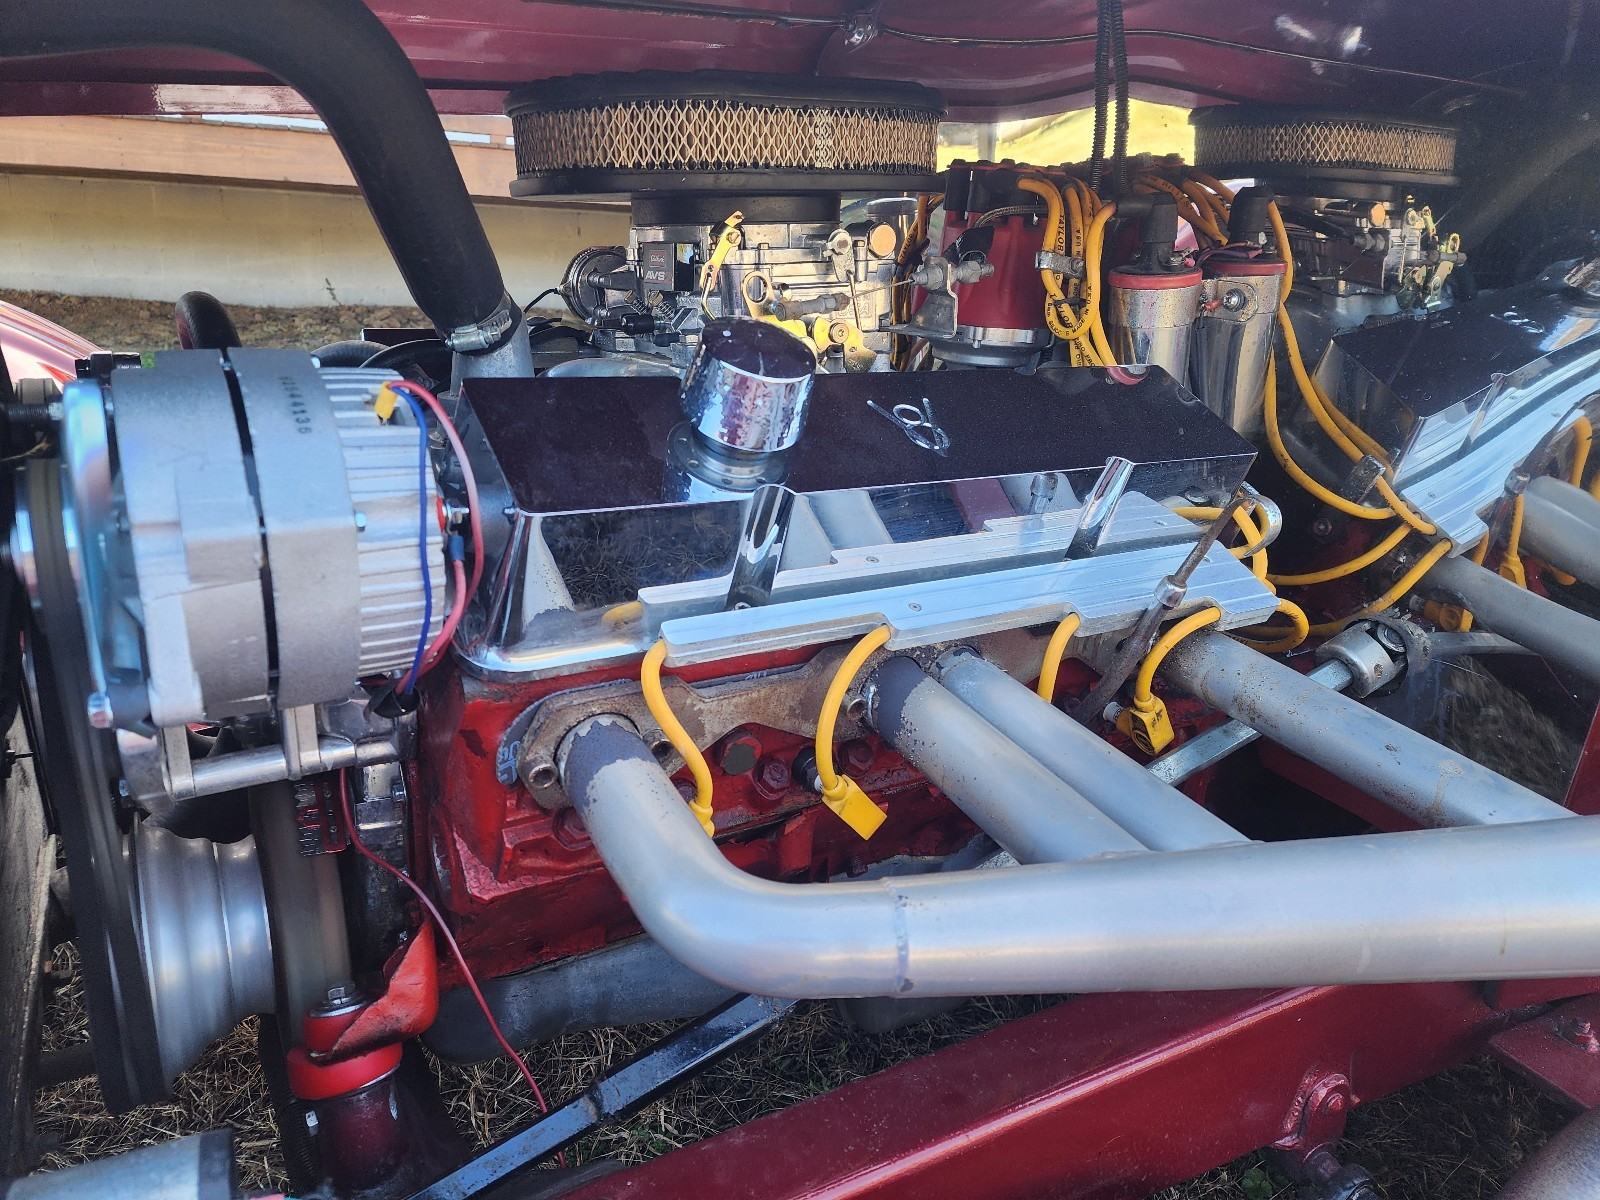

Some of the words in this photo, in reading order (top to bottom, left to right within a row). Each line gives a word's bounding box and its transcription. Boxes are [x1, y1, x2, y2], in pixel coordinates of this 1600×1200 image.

[1057, 214, 1065, 252] TAYLOR
[645, 270, 666, 281] AVS
[1071, 318, 1086, 334] MADE
